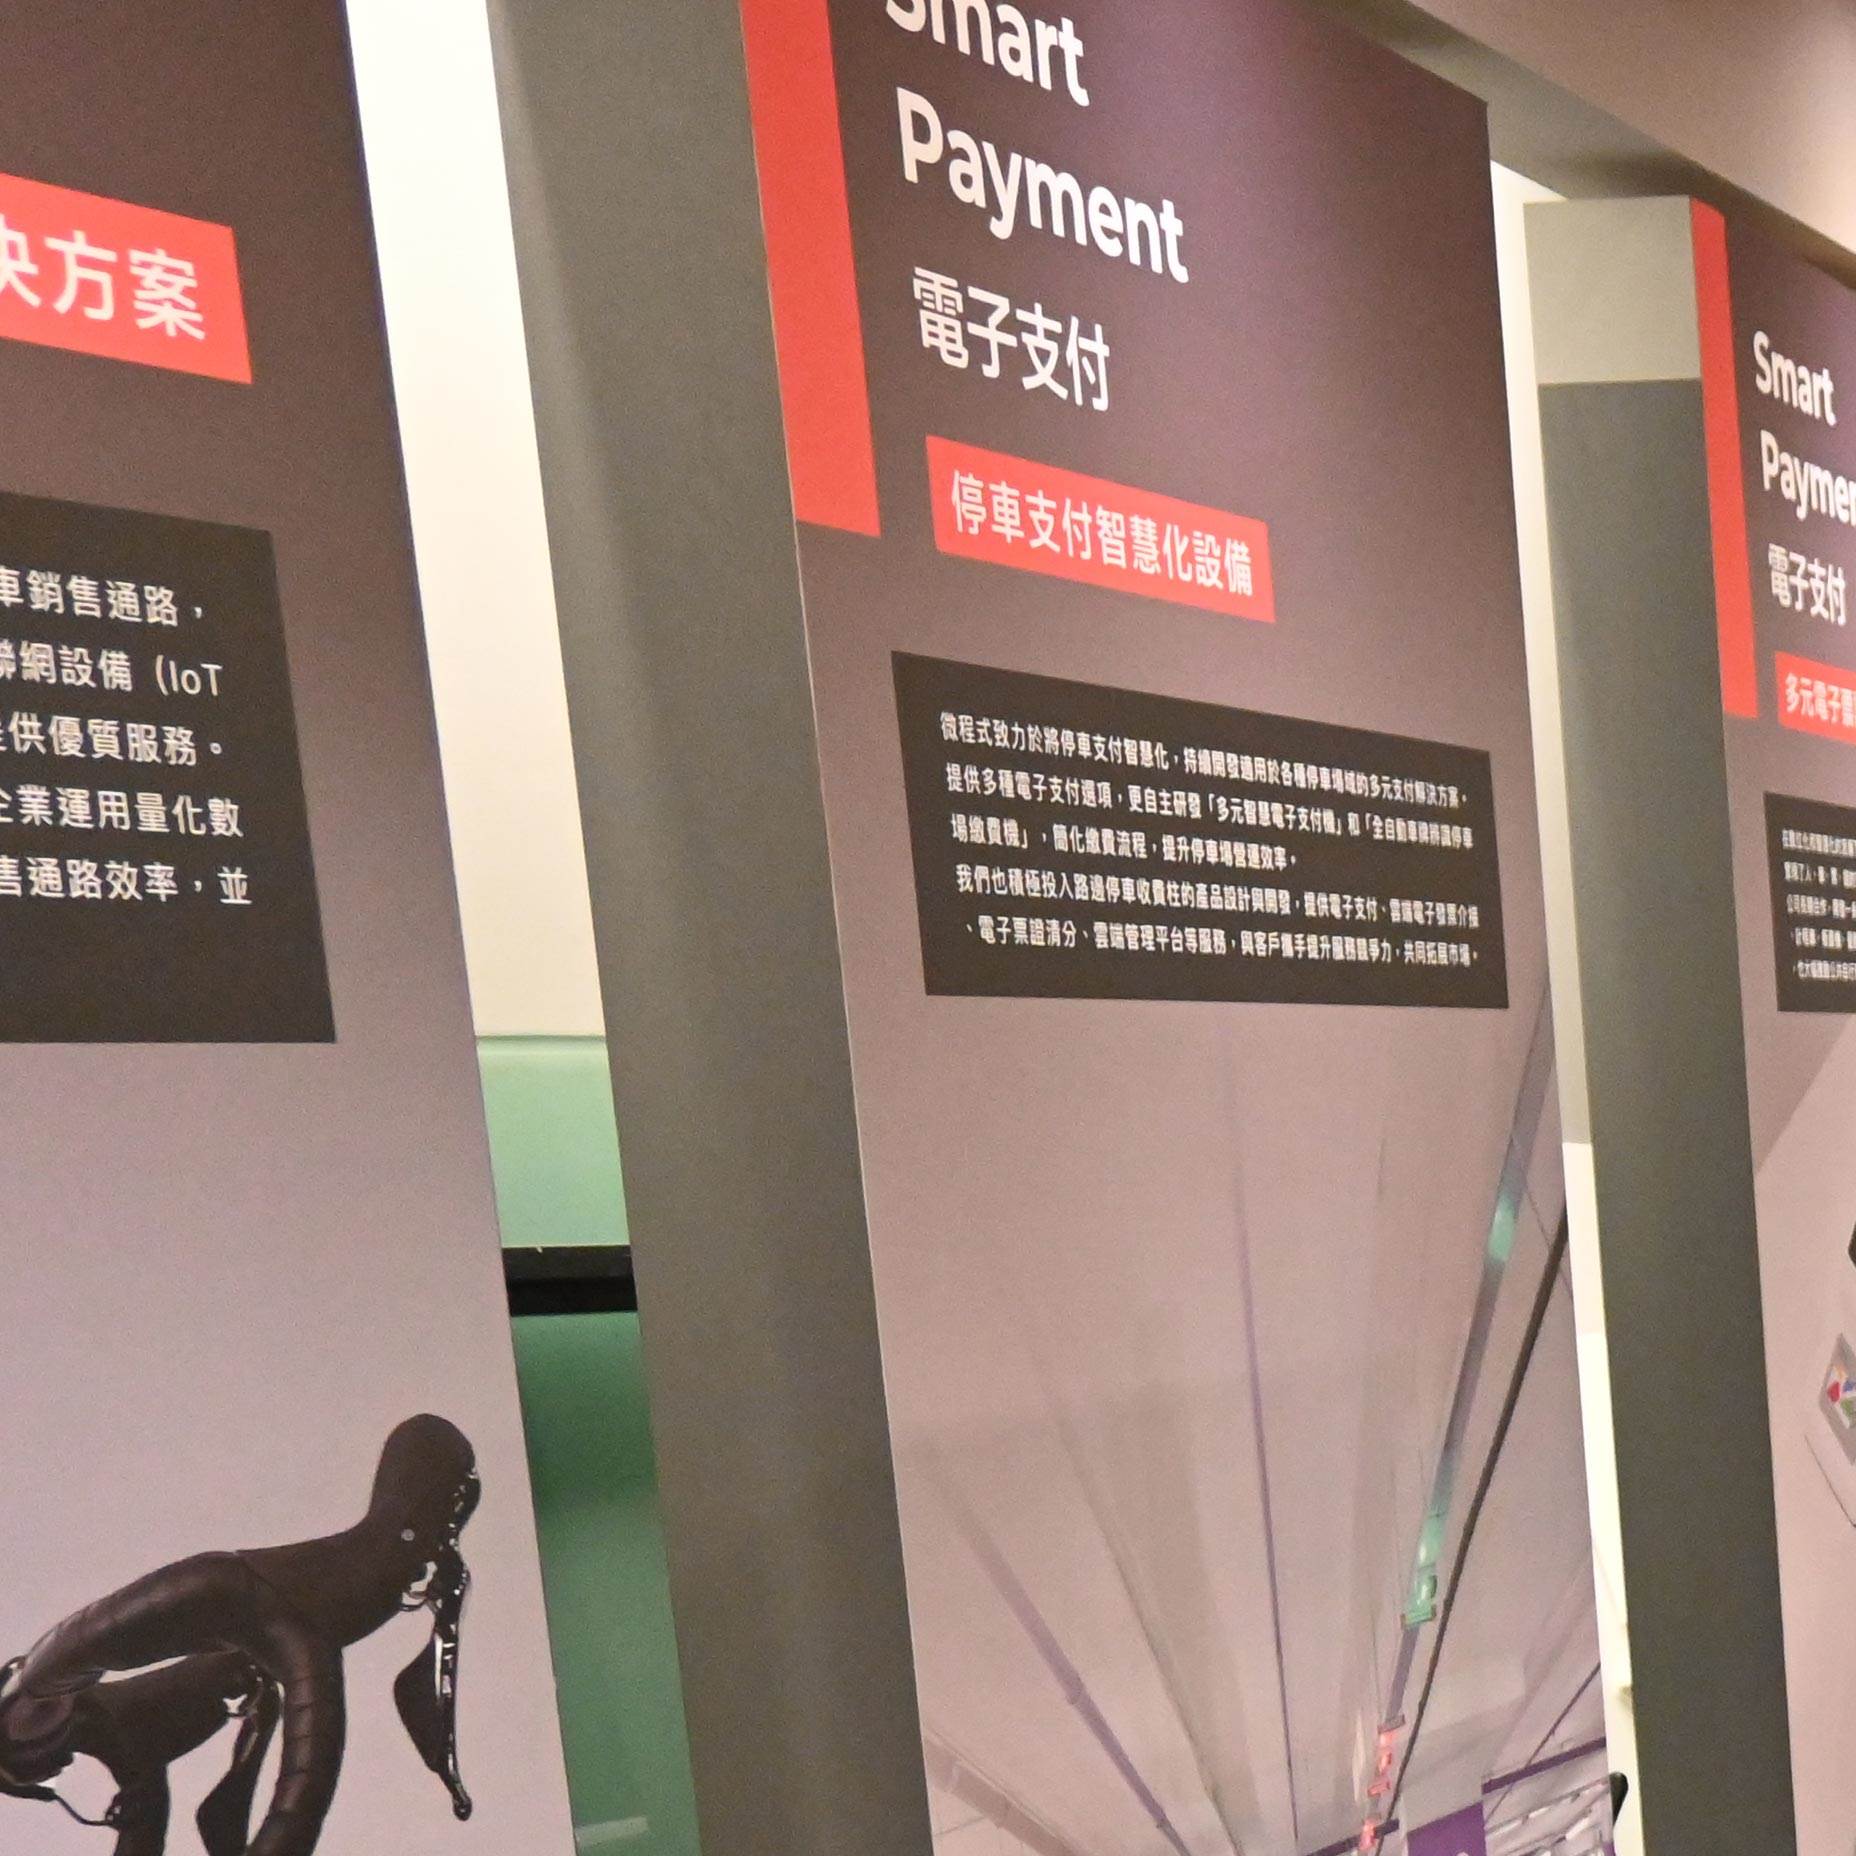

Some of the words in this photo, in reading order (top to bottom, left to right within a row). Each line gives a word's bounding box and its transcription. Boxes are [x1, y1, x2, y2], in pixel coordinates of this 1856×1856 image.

[897, 87, 1189, 283] Payment
[913, 266, 1110, 411] 電子支付
[1753, 330, 1837, 426] Smart
[951, 469, 1254, 597] 停車支付智慧化設備
[1768, 542, 1847, 627] 電子支付
[0, 711, 223, 767] 供優質服務。
